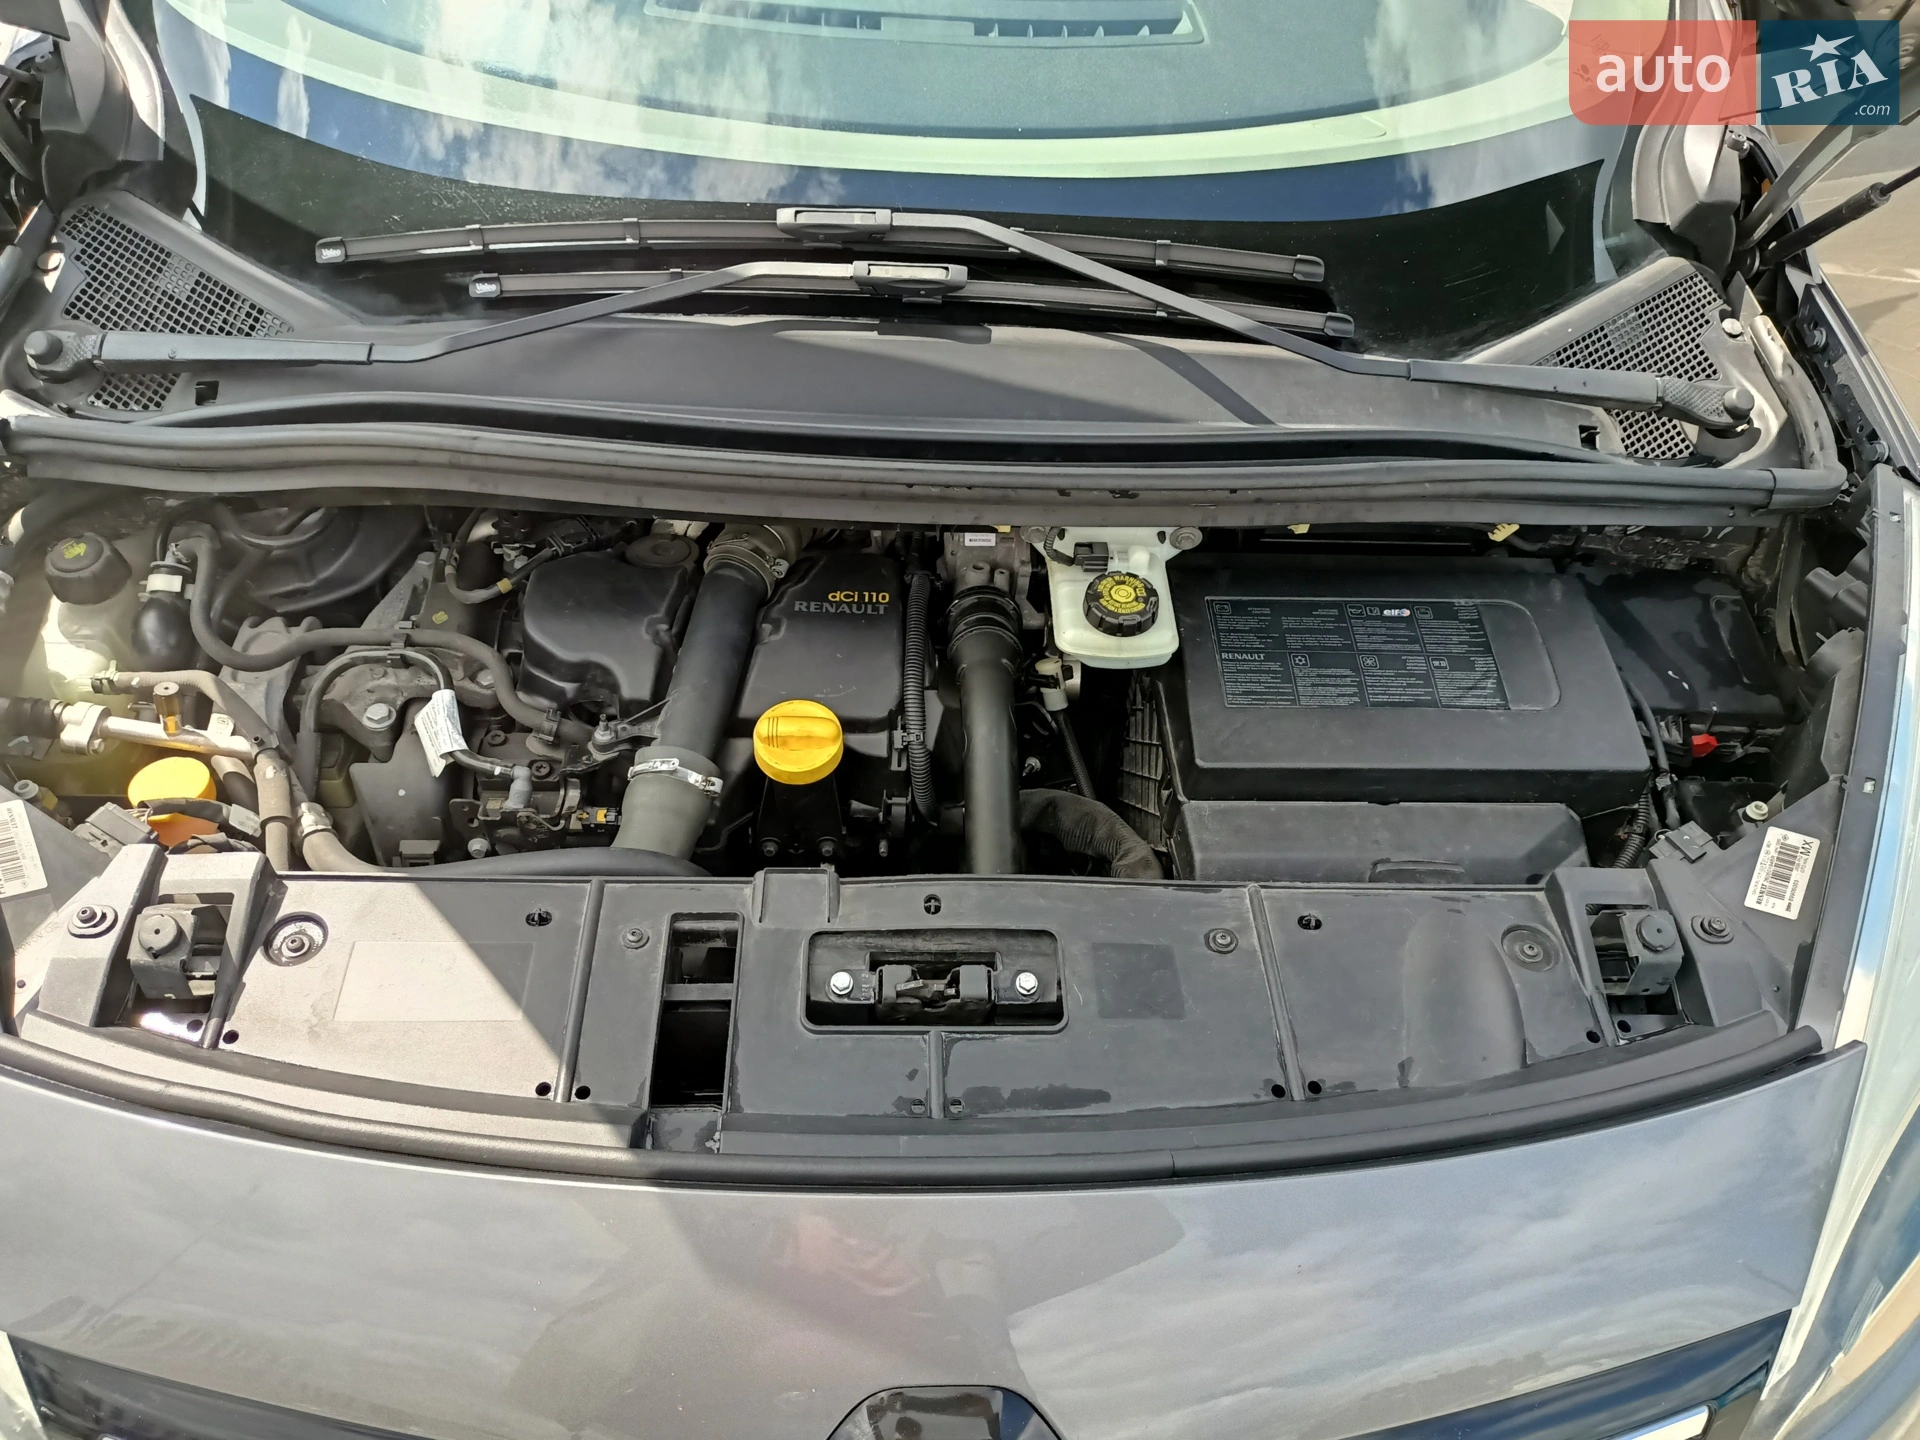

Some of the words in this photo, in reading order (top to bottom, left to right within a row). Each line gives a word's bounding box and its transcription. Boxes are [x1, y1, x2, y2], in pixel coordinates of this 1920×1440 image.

[828, 591, 859, 602] dCi
[863, 592, 890, 603] 110
[794, 601, 888, 614] RENAULT
[1221, 652, 1265, 661] RENAULT
[1799, 839, 1814, 856] MX
